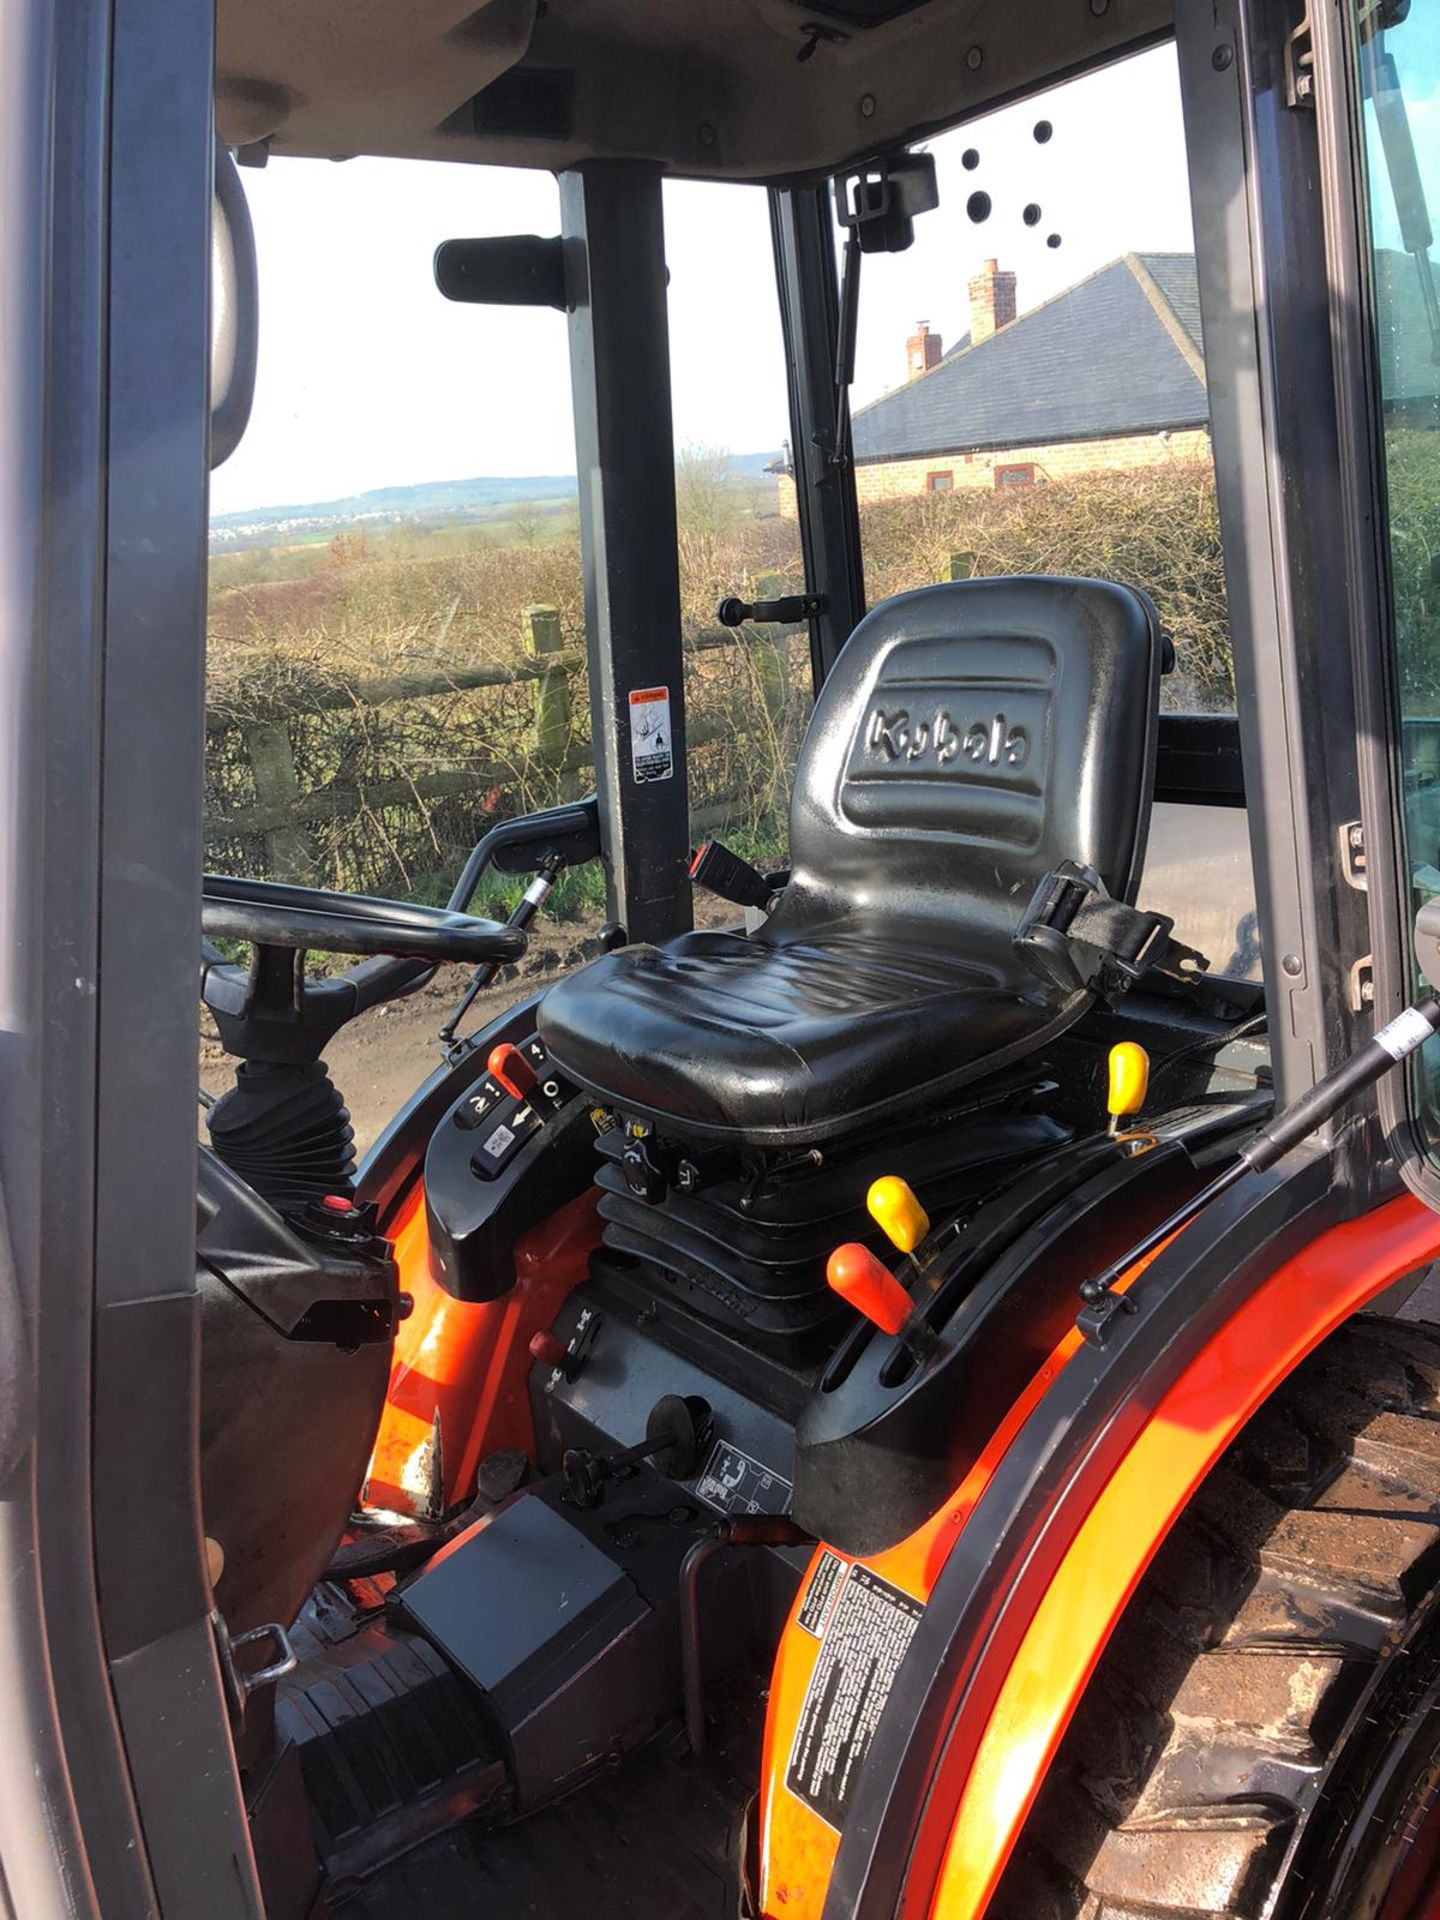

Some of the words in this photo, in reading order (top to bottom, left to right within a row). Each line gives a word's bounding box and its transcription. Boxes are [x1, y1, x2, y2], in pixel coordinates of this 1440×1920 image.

[863, 707, 1030, 770] Kubota
[808, 1596, 818, 1612] PTO
[816, 1594, 825, 1610] PTO
[820, 1570, 842, 1627] IMPORTANT
